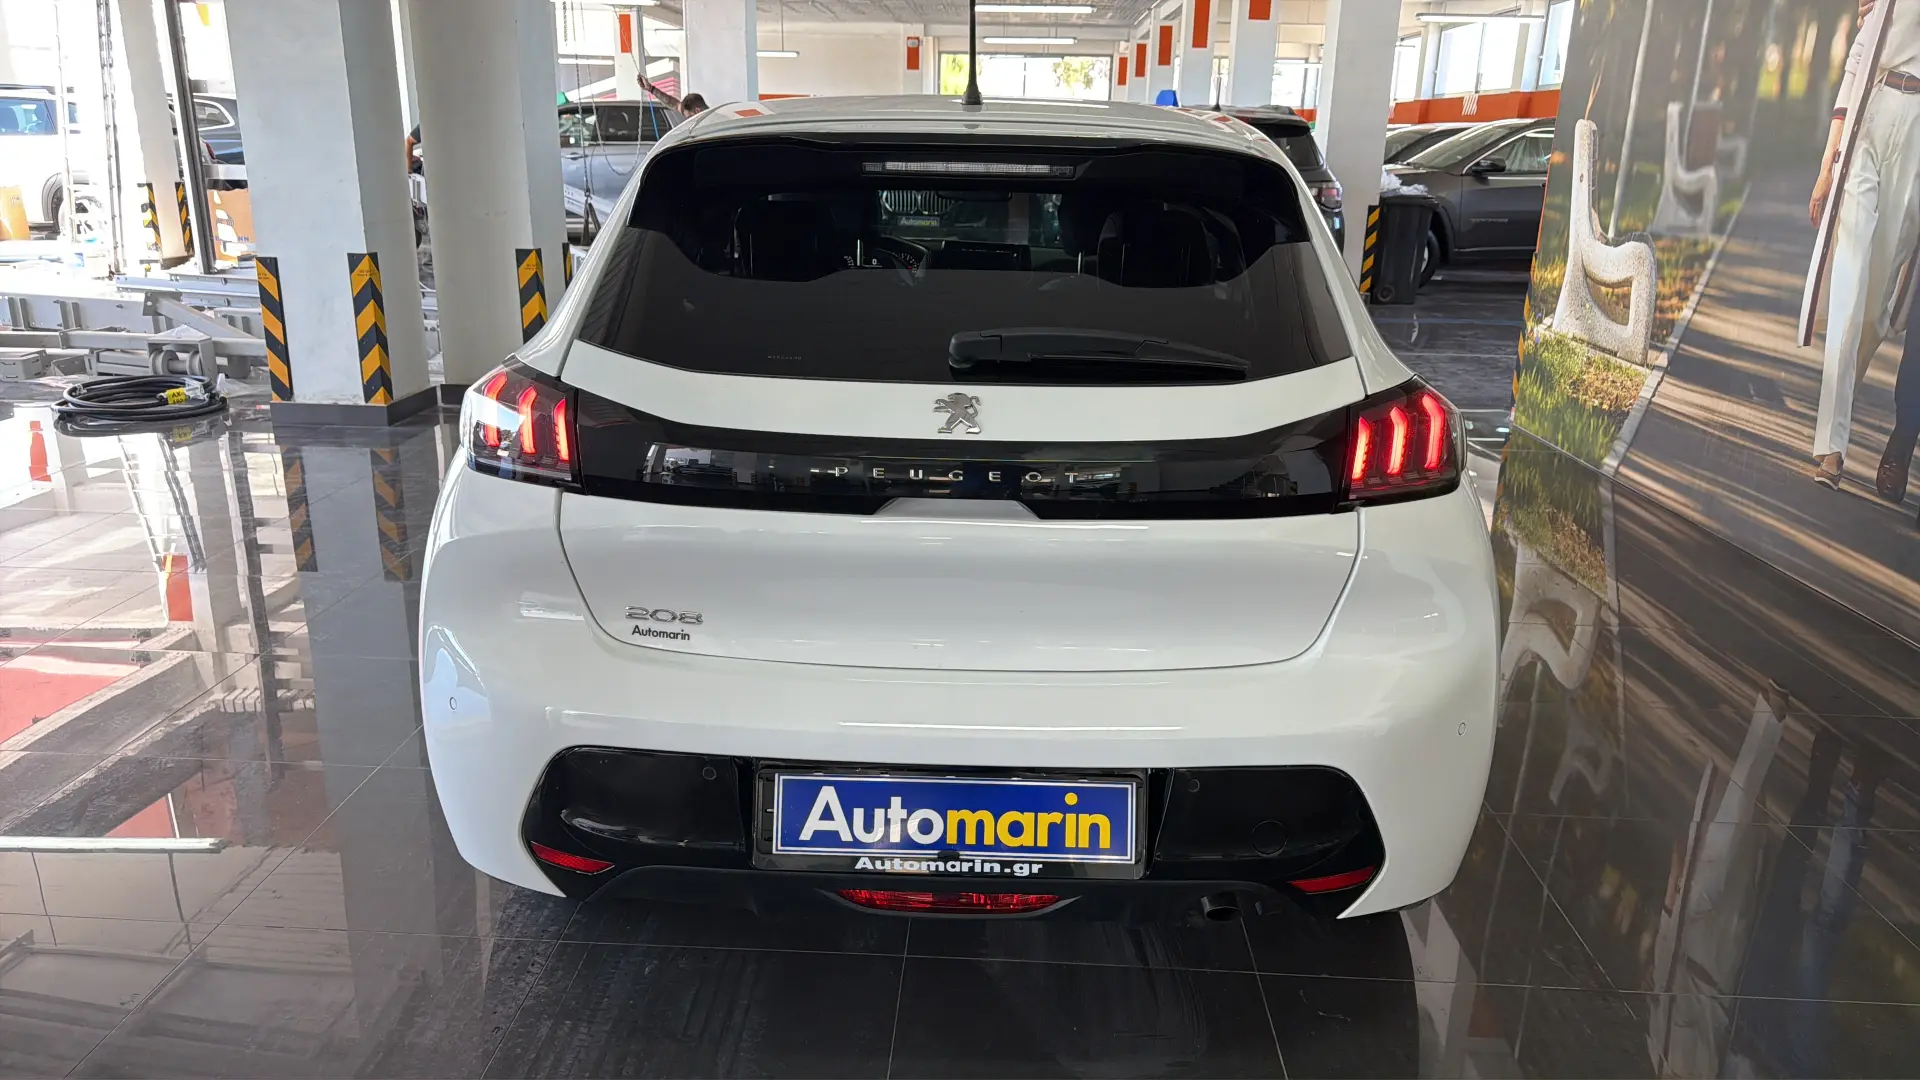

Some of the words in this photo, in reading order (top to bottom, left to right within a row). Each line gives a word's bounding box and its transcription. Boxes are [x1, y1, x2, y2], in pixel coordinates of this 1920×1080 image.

[835, 466, 1079, 484] PEUGEOT
[625, 606, 704, 625] 208
[631, 624, 691, 641] Automarin
[798, 785, 1111, 849] Automarin
[855, 857, 1044, 877] Automarin.gr
